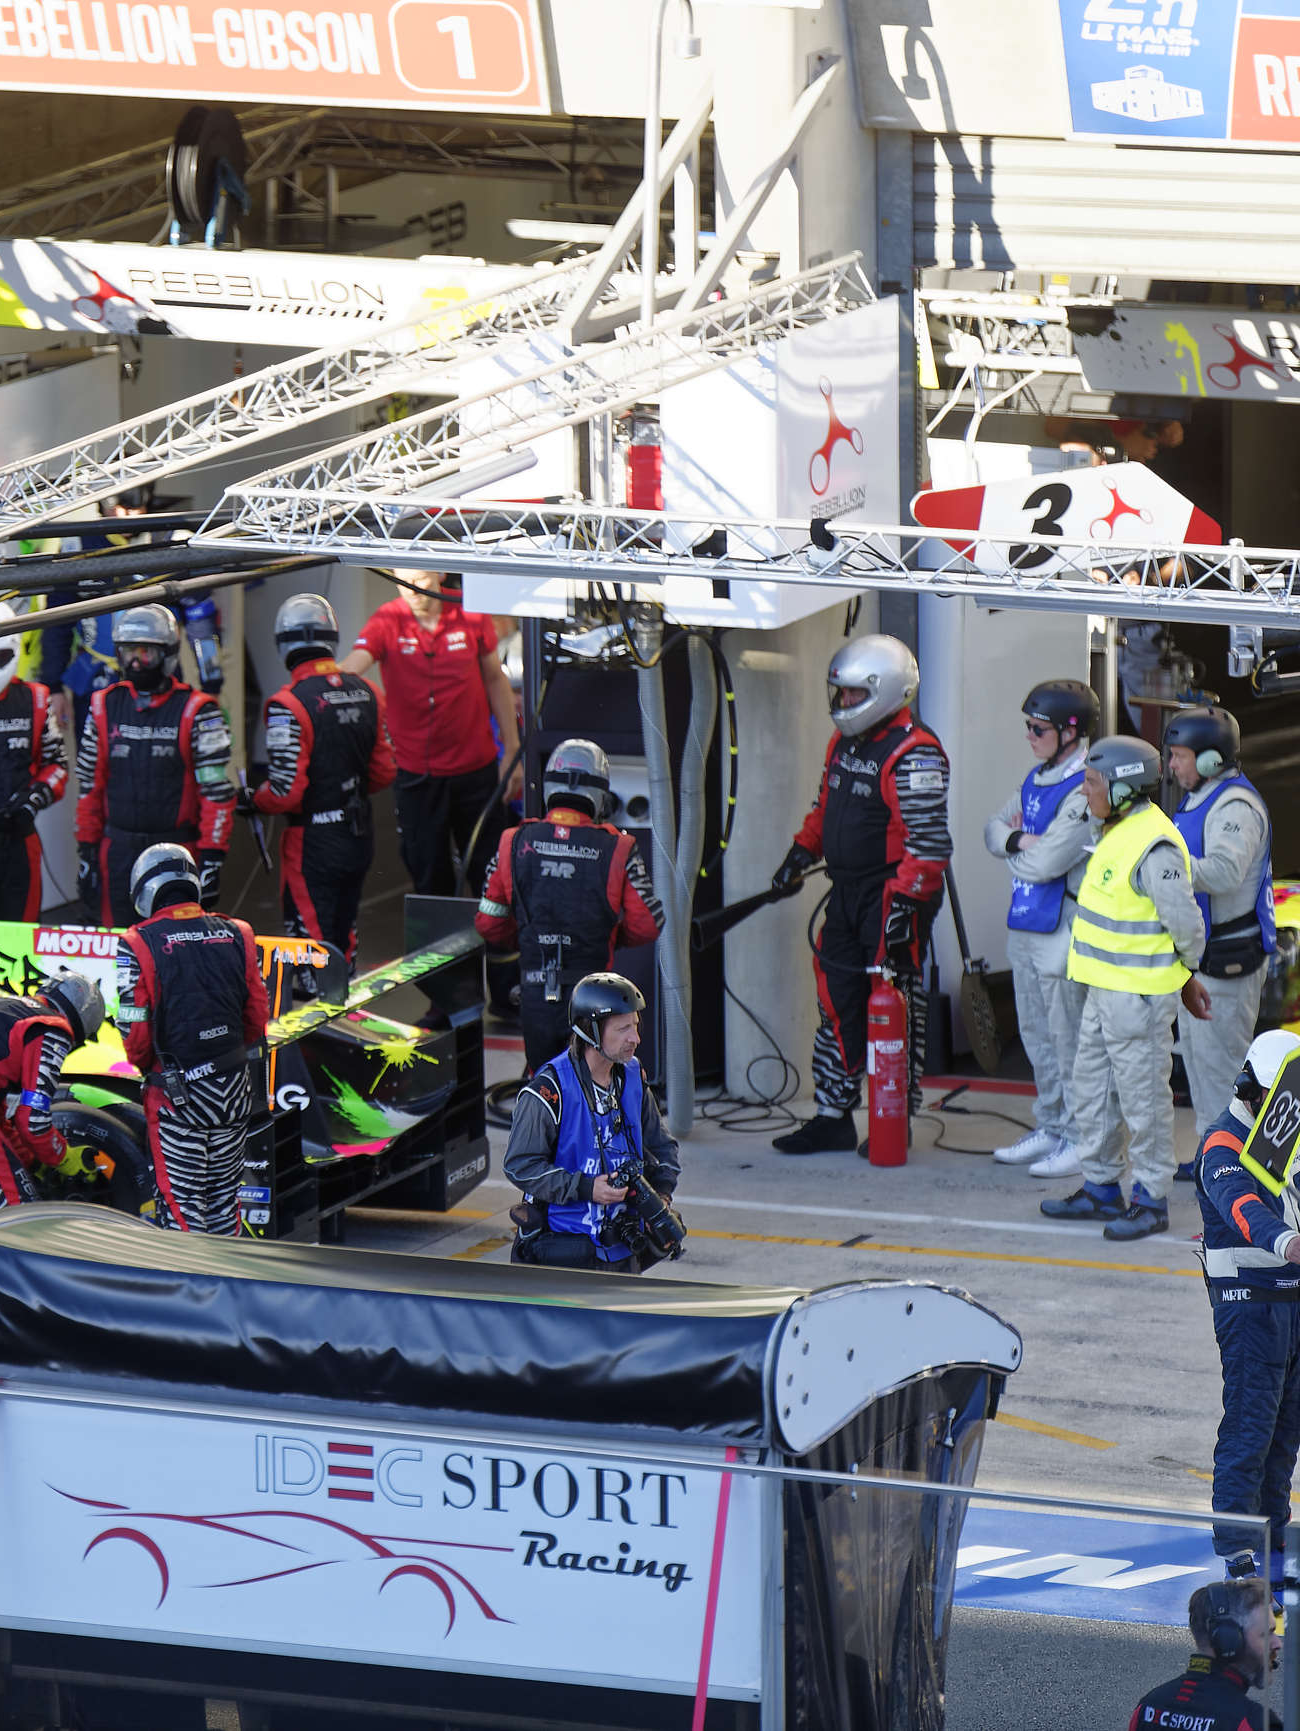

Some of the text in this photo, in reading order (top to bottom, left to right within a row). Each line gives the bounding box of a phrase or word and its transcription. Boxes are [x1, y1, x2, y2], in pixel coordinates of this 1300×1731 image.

[1081, 22, 1115, 41] LE
[436, 15, 478, 80] 1
[128, 269, 385, 305] REBELLION
[1008, 483, 1073, 569] 3
[166, 928, 235, 944] REBELLION
[185, 1062, 216, 1083] MRTC
[1222, 1288, 1252, 1302] MRTC
[255, 1435, 688, 1530] IDEC SPORT
[520, 1530, 693, 1593] Racing
[1170, 1713, 1215, 1731] SPORT
